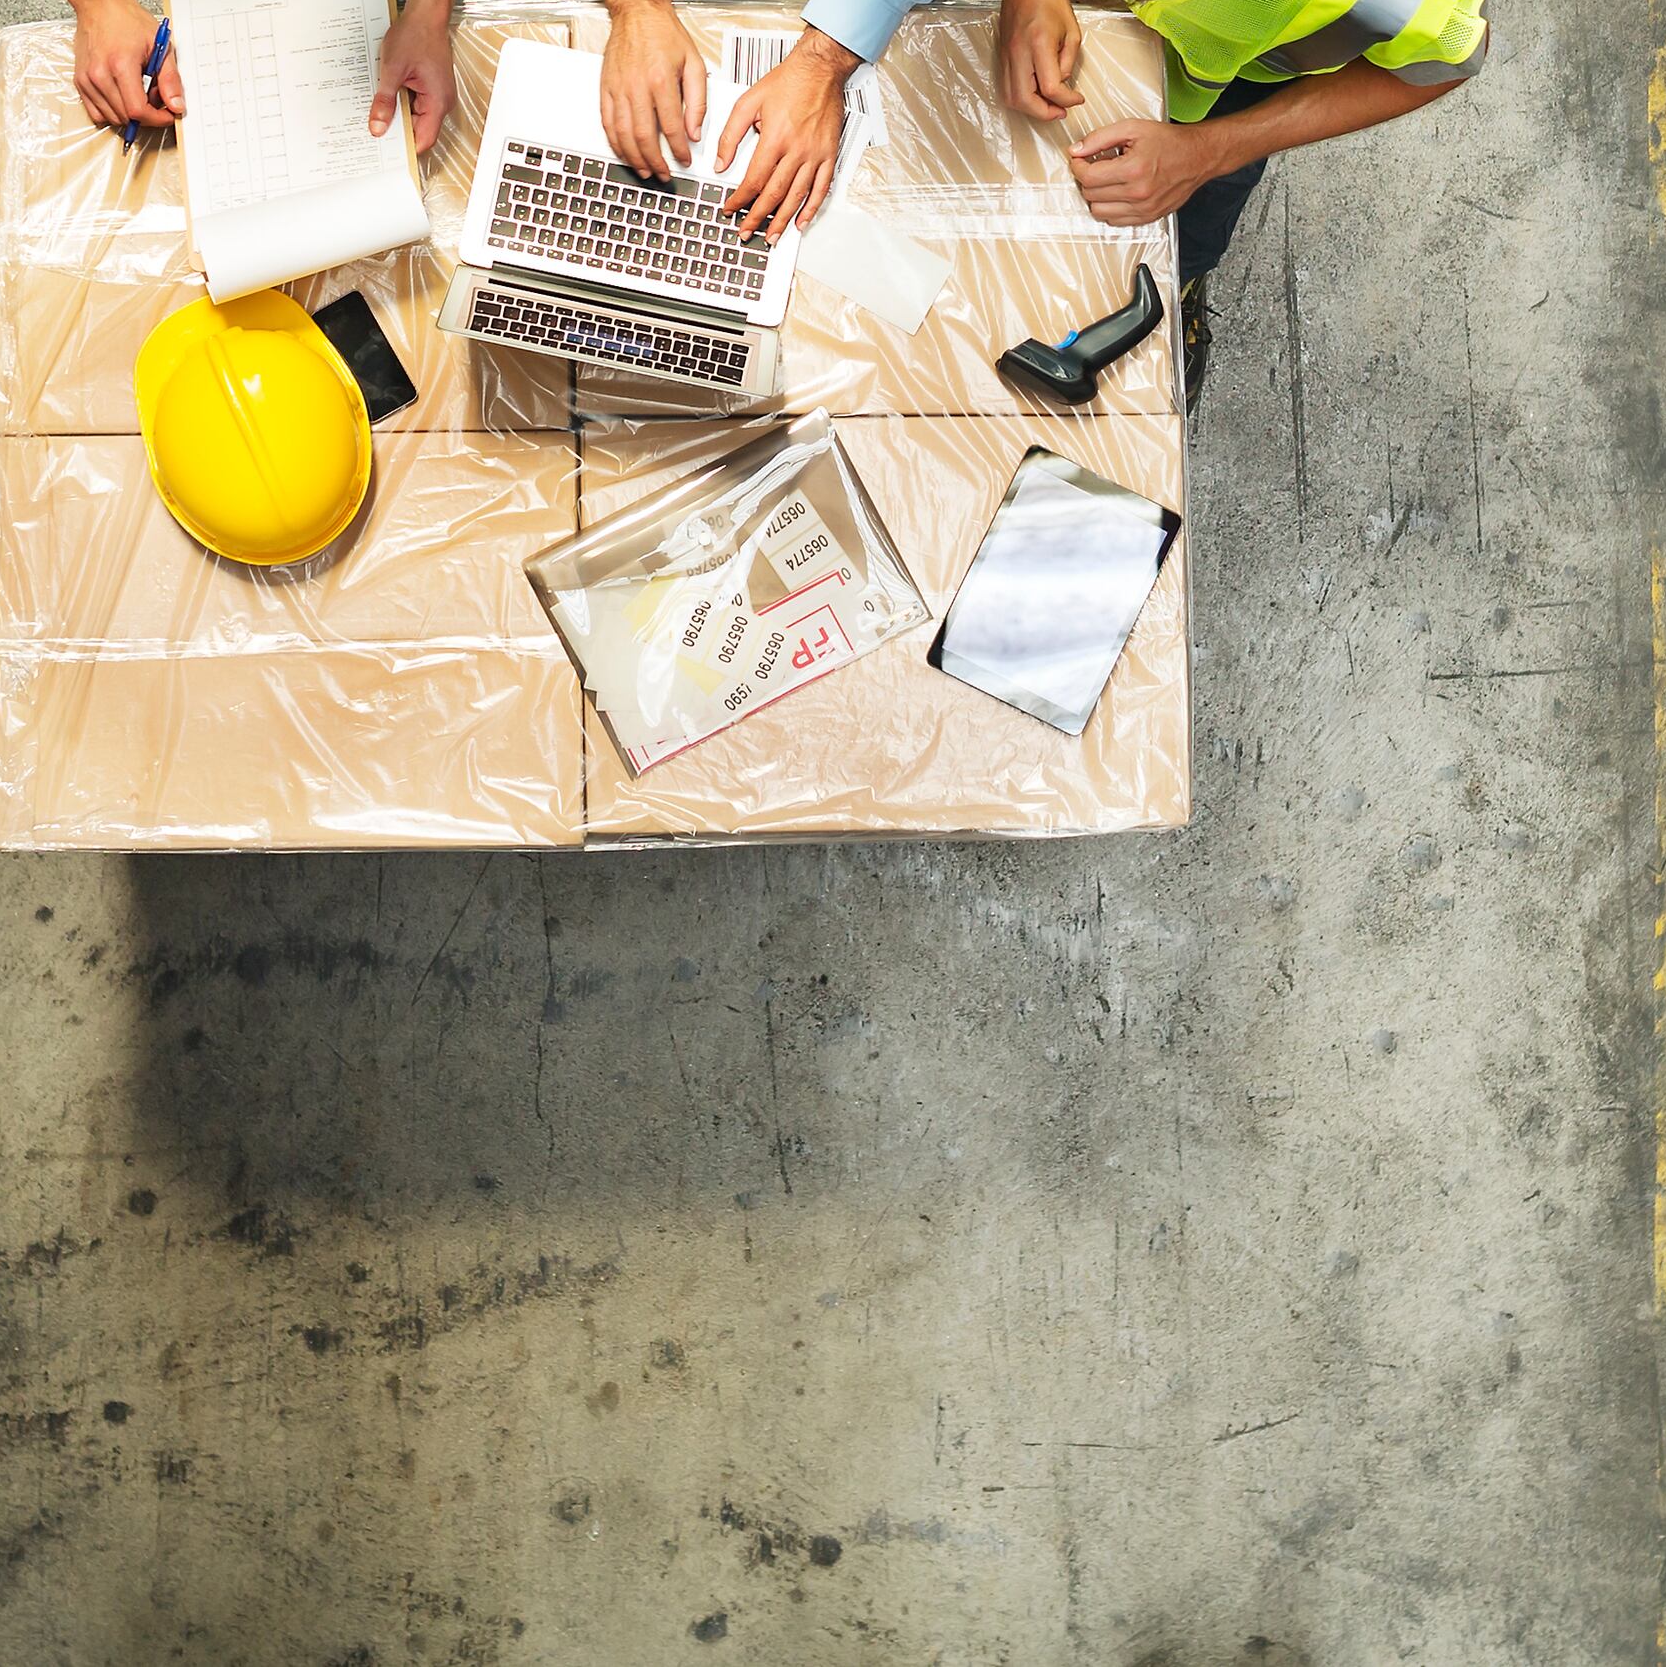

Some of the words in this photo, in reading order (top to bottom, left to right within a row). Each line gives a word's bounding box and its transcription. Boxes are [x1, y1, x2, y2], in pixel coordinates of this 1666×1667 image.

[783, 533, 830, 573] 065774
[680, 600, 713, 648] 065790
[717, 615, 749, 665] 065790
[753, 630, 786, 681] 065790
